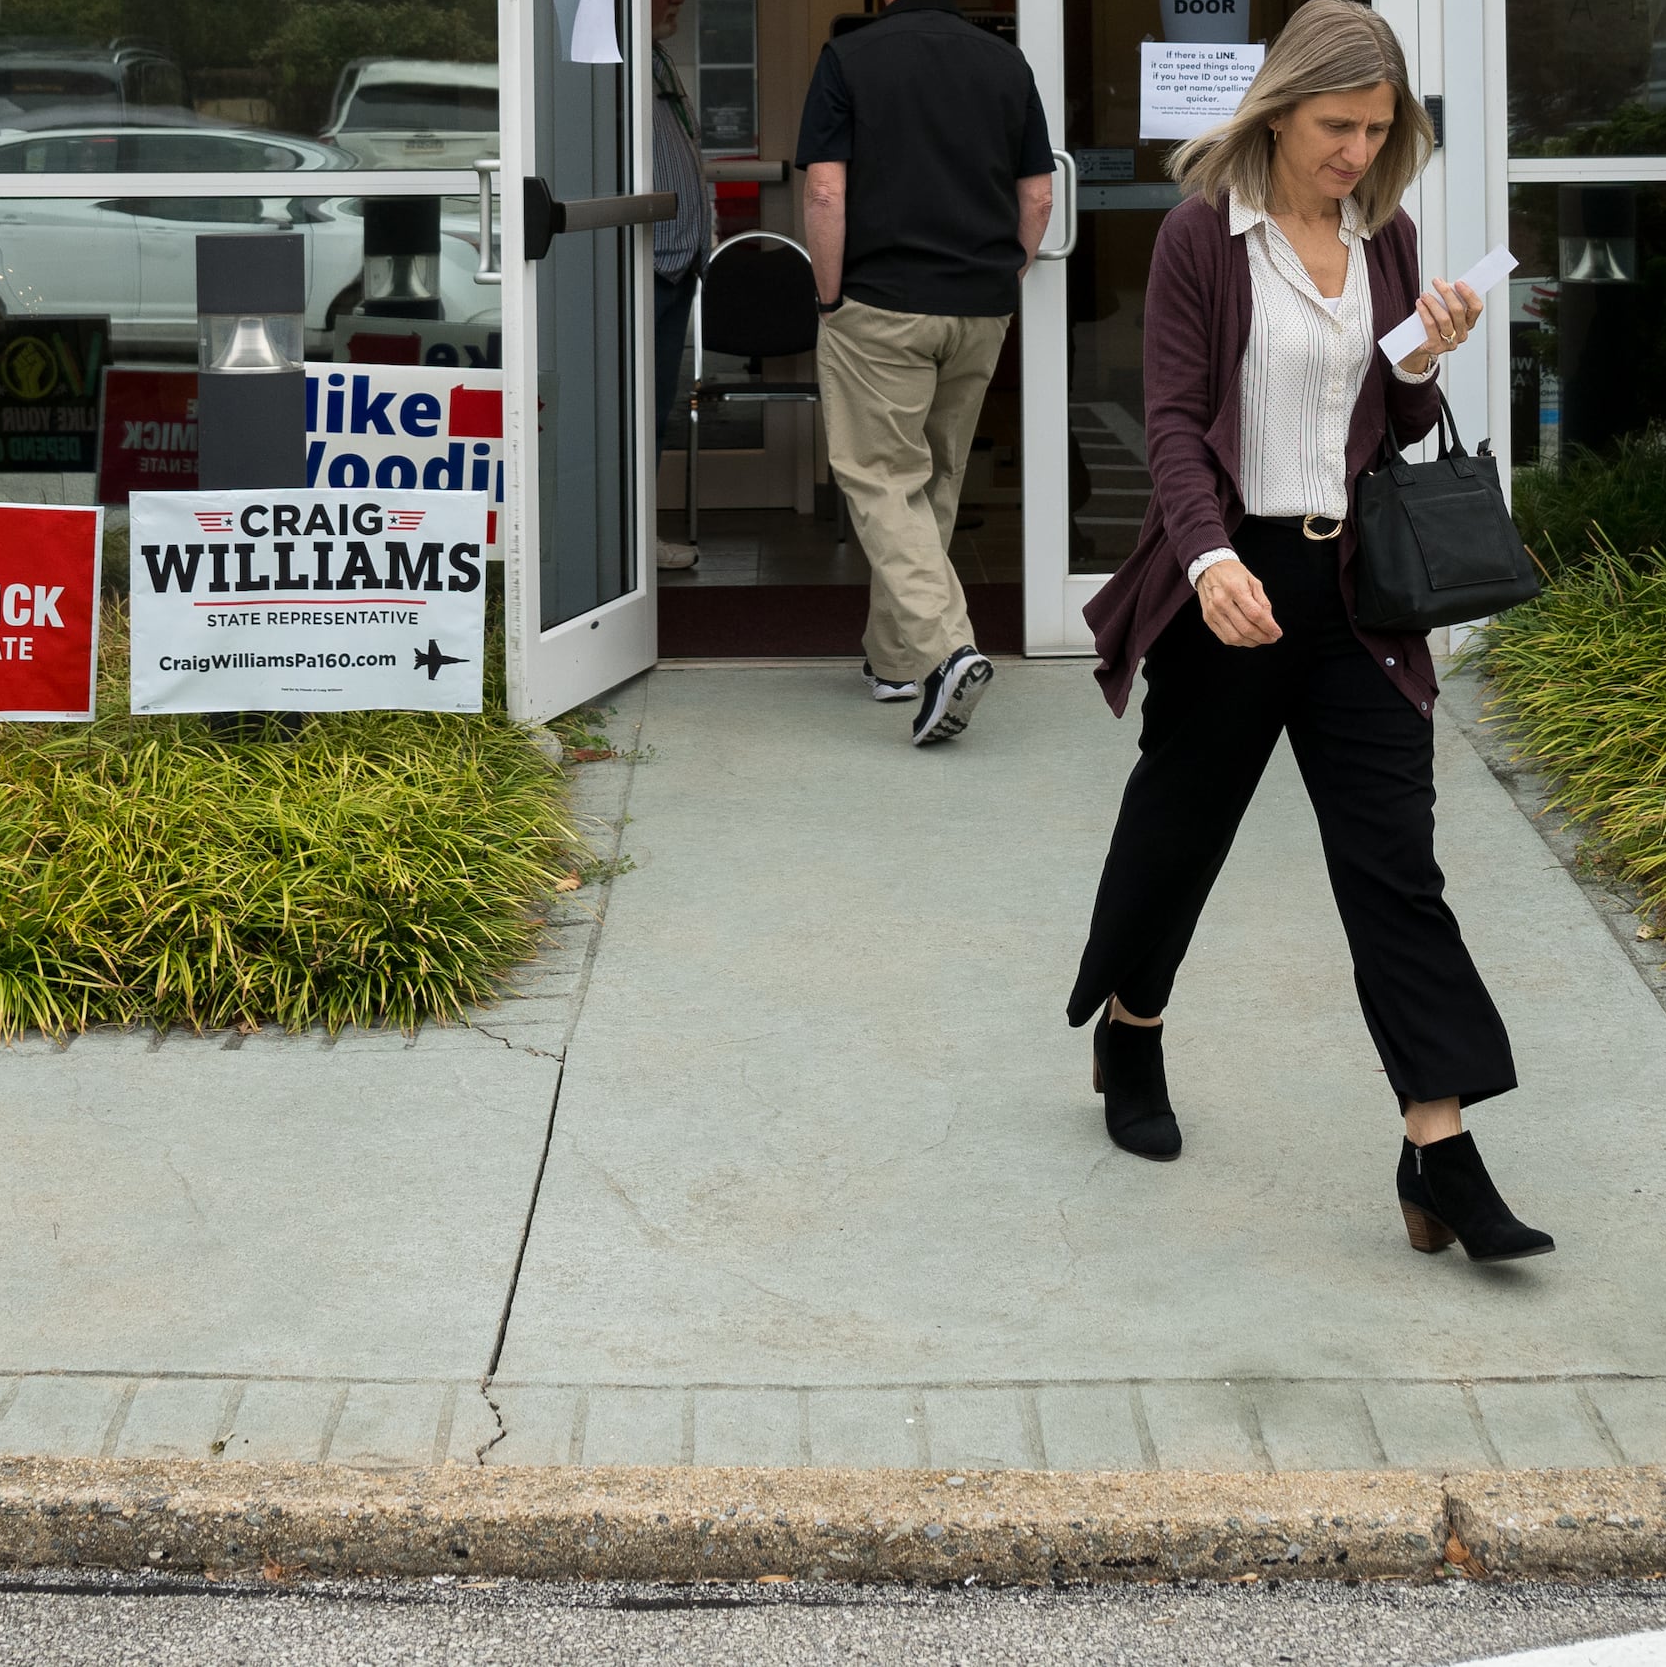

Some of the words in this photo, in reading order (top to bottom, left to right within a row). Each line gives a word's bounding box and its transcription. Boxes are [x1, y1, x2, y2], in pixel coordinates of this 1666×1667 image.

[1174, 0, 1236, 14] DOOR
[1166, 50, 1173, 59] If
[1174, 51, 1196, 60] there
[1198, 51, 1205, 59] is
[1215, 52, 1238, 61] LINE,
[1151, 61, 1156, 69] it
[1176, 62, 1201, 71] speed
[1203, 62, 1229, 72] things
[1231, 63, 1255, 72] along
[1152, 72, 1159, 80] if
[1160, 74, 1176, 82] you
[1178, 72, 1199, 80] have
[1201, 73, 1211, 81] ID
[1173, 85, 1187, 93] get
[1186, 95, 1219, 104] quicker.
[306, 441, 504, 502] oodi
[240, 503, 383, 537] CRAIG
[141, 540, 482, 593] WILLIAMS
[207, 612, 261, 627] STATE
[267, 611, 419, 626] REPRESENTATIVE
[159, 652, 396, 673] CraigWilliamsPa160.com
